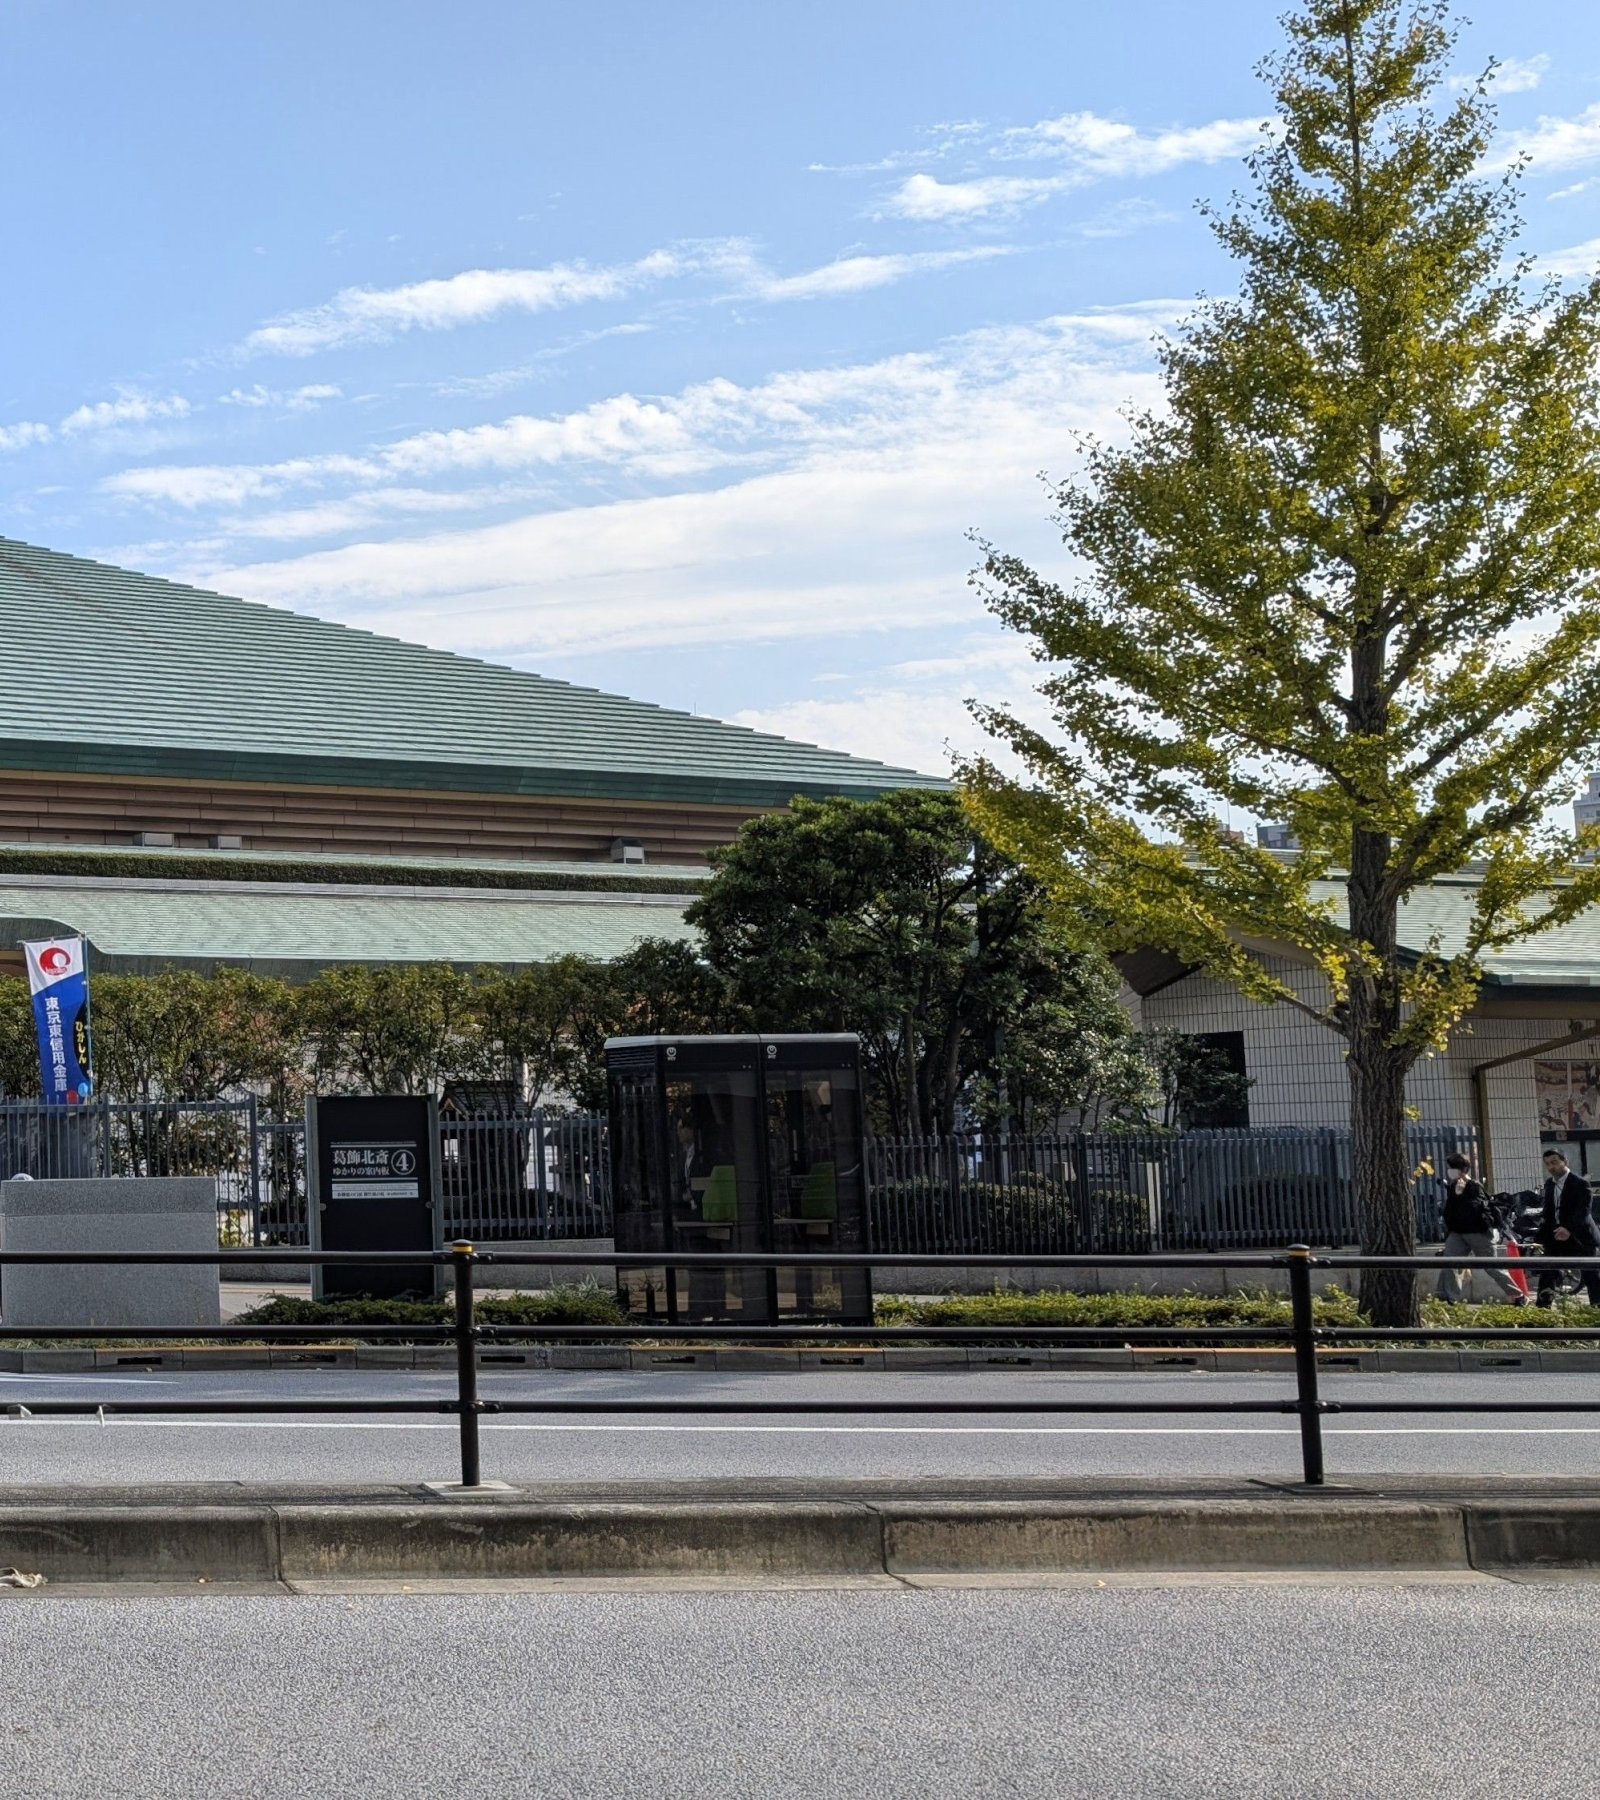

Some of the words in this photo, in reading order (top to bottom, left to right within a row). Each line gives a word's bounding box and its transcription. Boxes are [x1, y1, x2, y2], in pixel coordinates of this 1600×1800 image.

[44, 996, 67, 1092] 東京東信用金庫
[333, 1149, 389, 1165] 葛飾北斎
